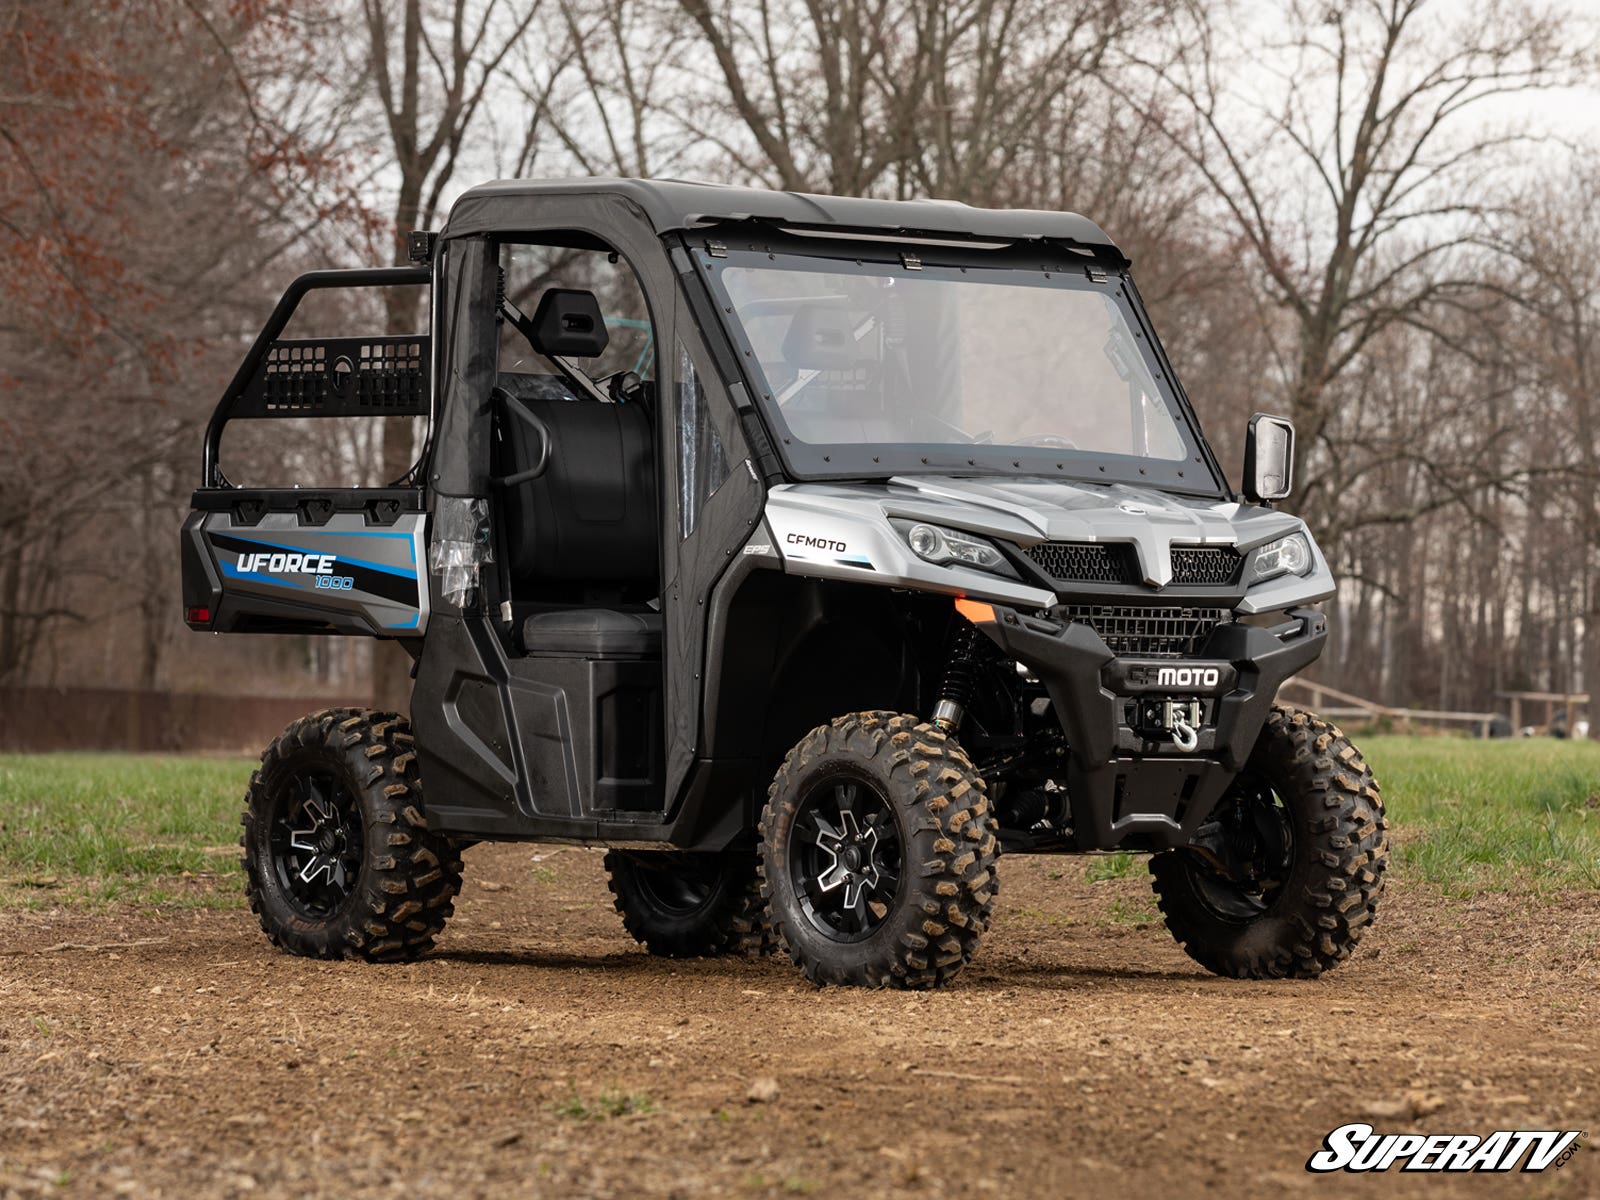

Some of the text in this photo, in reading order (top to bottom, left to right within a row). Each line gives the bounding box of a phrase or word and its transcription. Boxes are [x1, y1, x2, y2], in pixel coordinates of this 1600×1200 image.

[743, 545, 770, 555] EPS
[787, 533, 846, 552] CFMOTO
[236, 553, 336, 573] UFORCE
[314, 575, 354, 590] 1000
